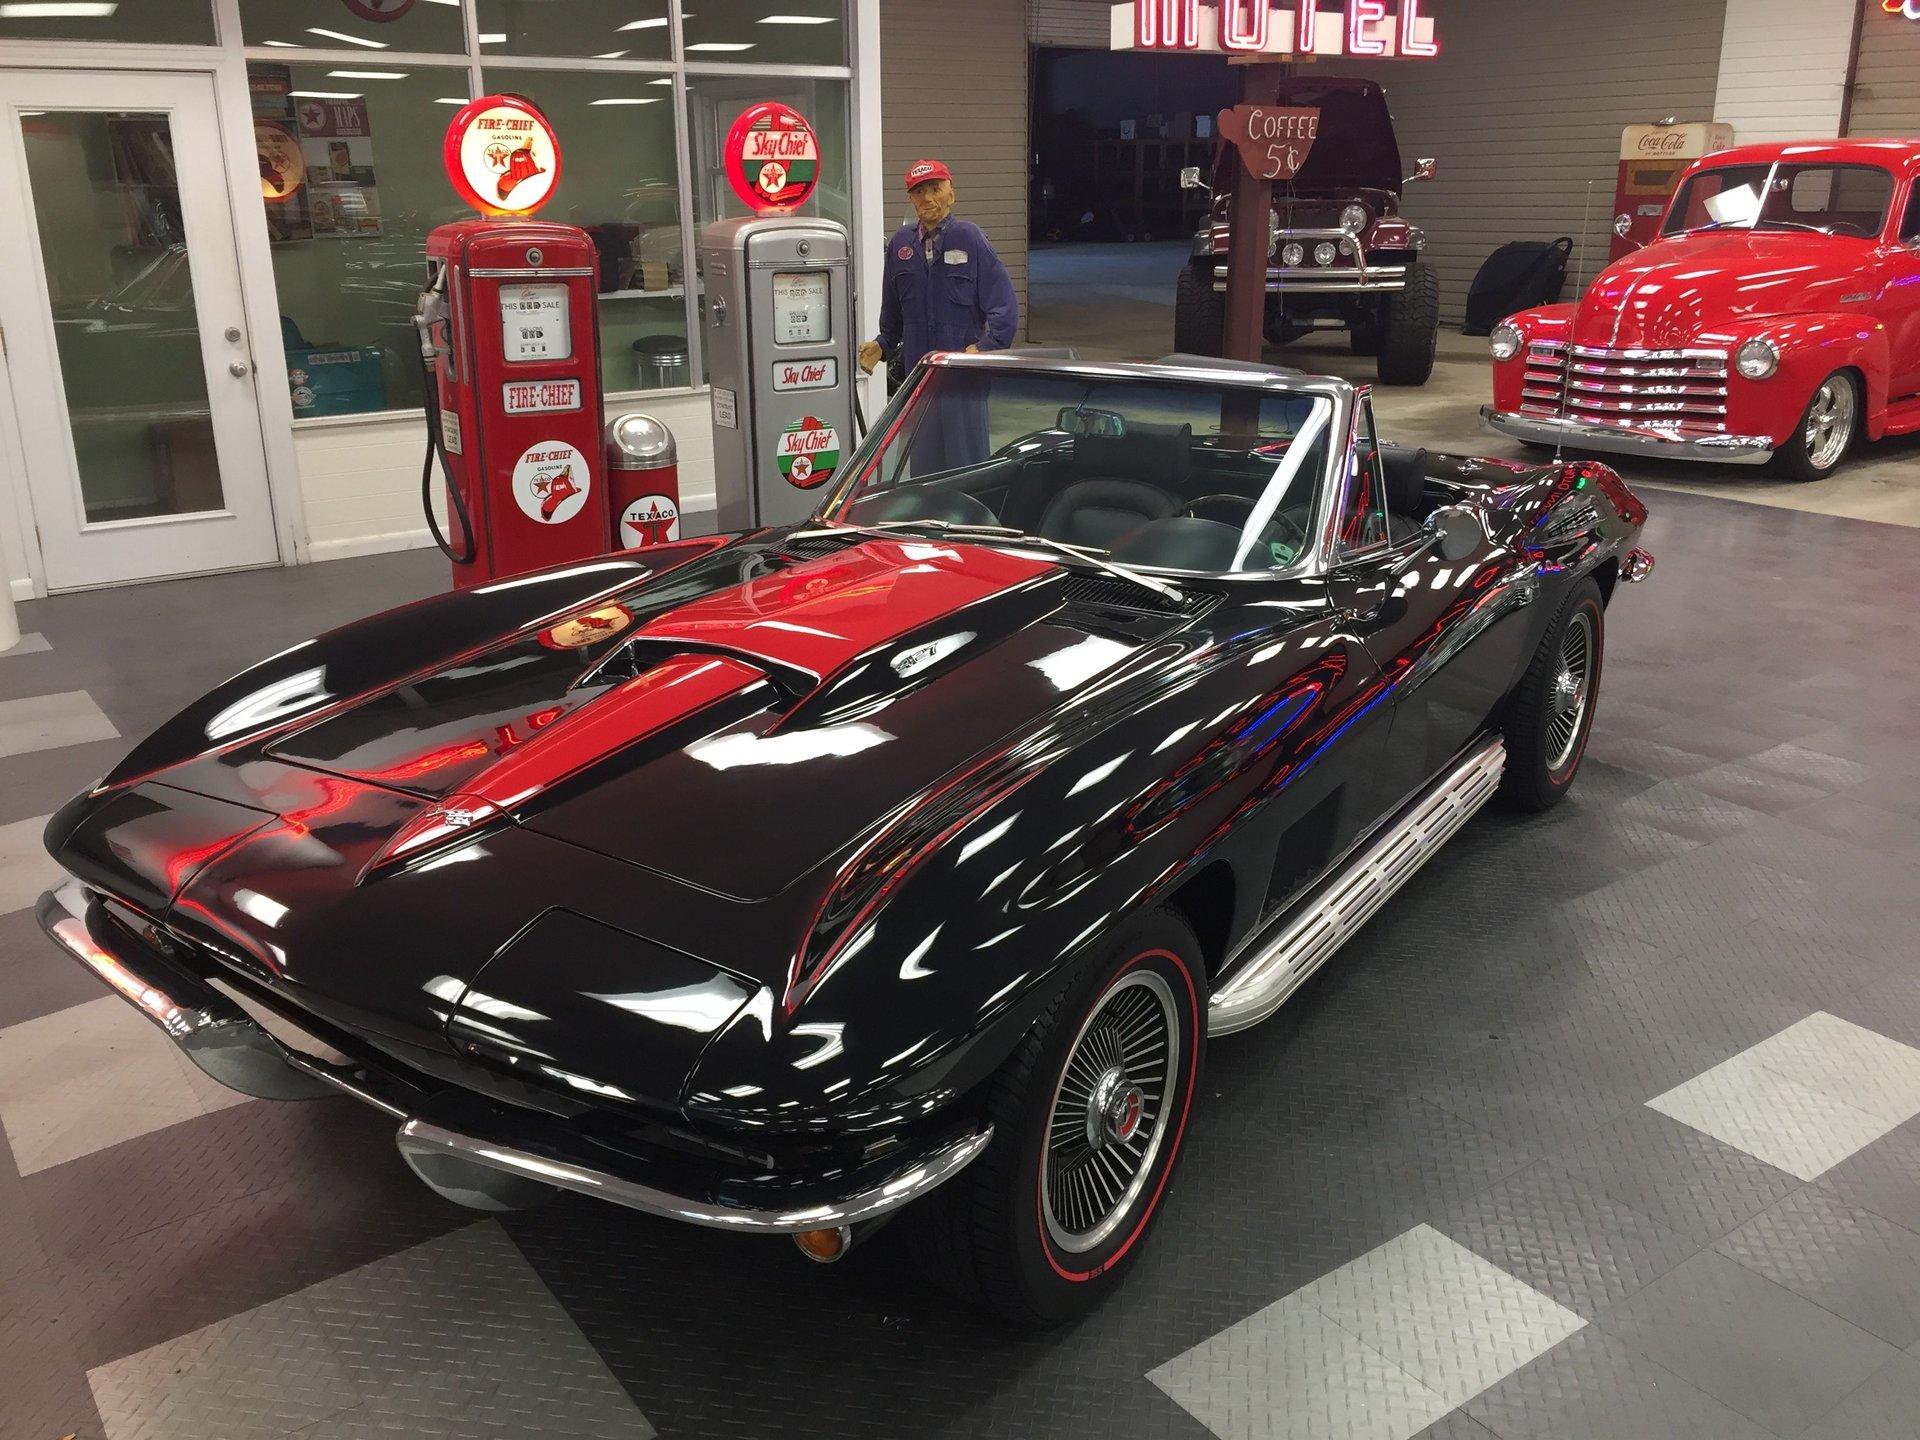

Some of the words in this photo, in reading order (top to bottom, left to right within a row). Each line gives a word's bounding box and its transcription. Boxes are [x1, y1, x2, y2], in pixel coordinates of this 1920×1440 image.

[477, 118, 534, 131] FIRE-CHIEF
[752, 132, 777, 158] Sky
[778, 132, 808, 156] Chief
[911, 164, 932, 176] TEXACO
[500, 302, 517, 310] THIS
[541, 301, 560, 309] SALE
[782, 367, 800, 385] Sky
[801, 364, 827, 382] Chief
[509, 383, 575, 409] FIRE-CHIEF
[785, 433, 805, 453] Sky
[805, 430, 832, 451] Chief
[525, 450, 573, 463] FIRE-CHIEF
[630, 509, 674, 521] TEXACO
[896, 641, 939, 672] 427
